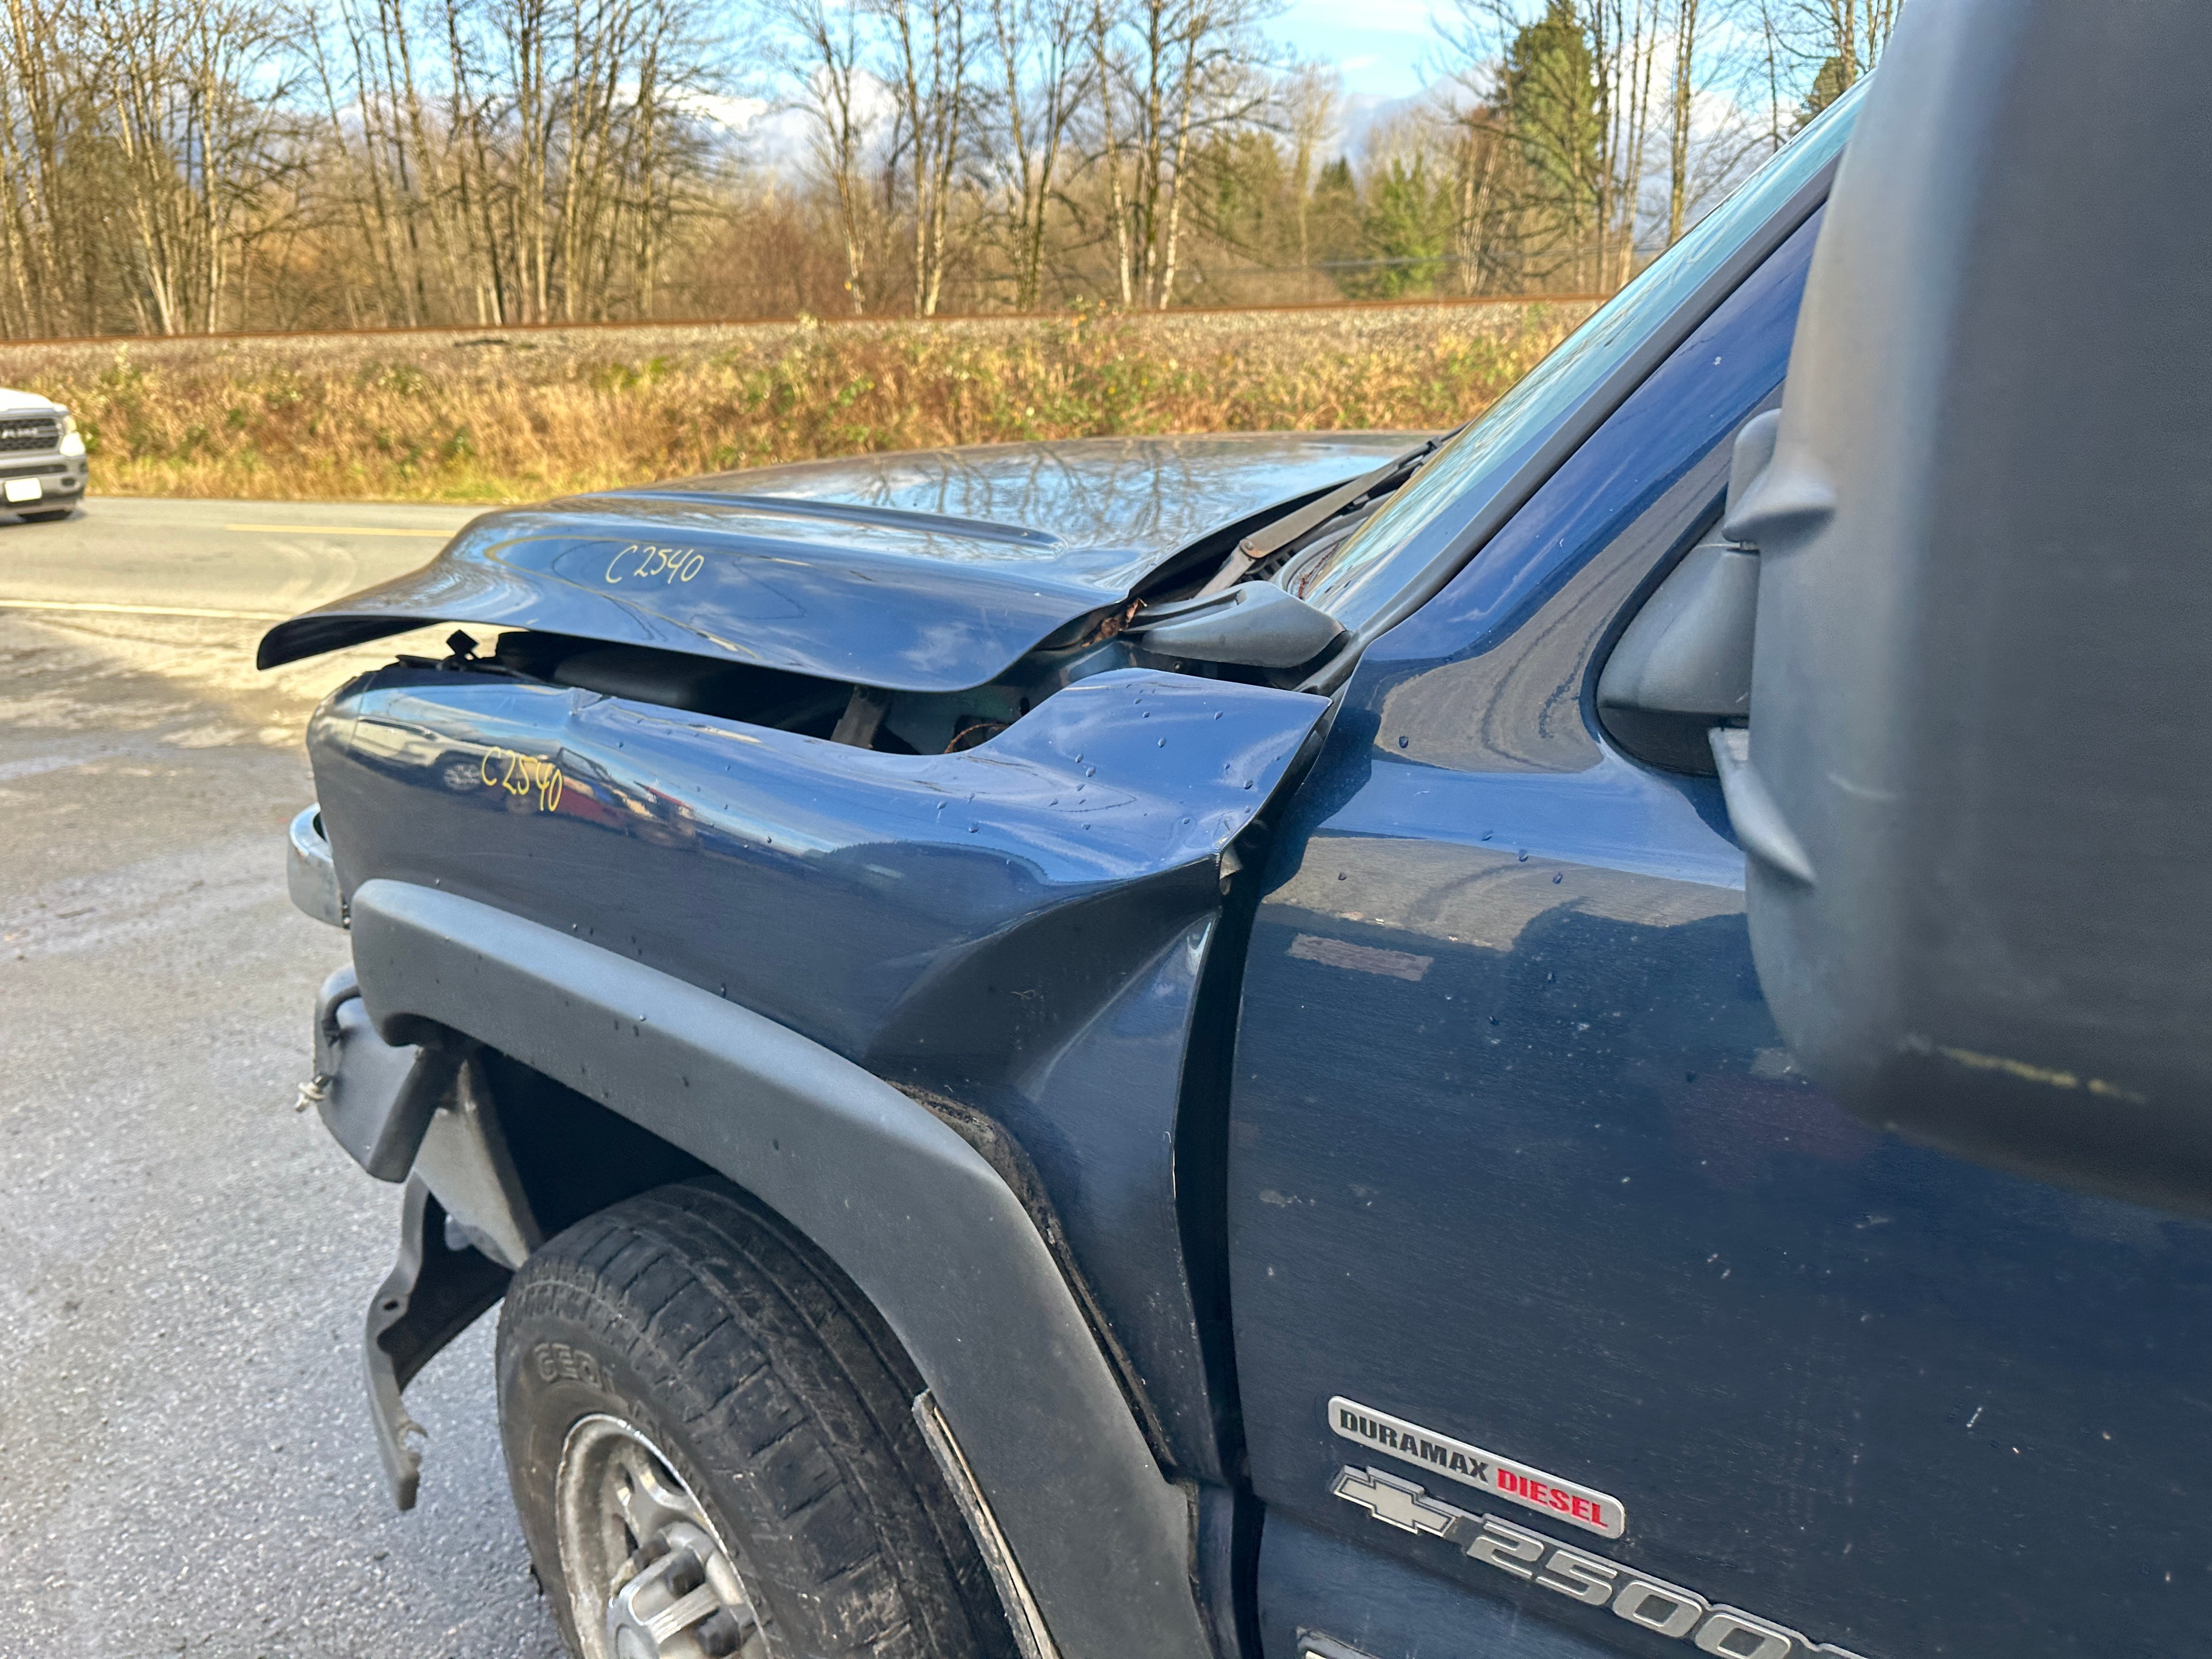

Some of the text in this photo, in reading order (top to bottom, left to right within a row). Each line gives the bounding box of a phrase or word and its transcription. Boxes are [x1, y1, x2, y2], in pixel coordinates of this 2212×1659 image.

[605, 545, 704, 584] C2540
[482, 747, 562, 812] C2540
[1340, 1409, 1608, 1529] DURAMAX DIESEL
[1467, 1521, 1791, 1659] 2500
